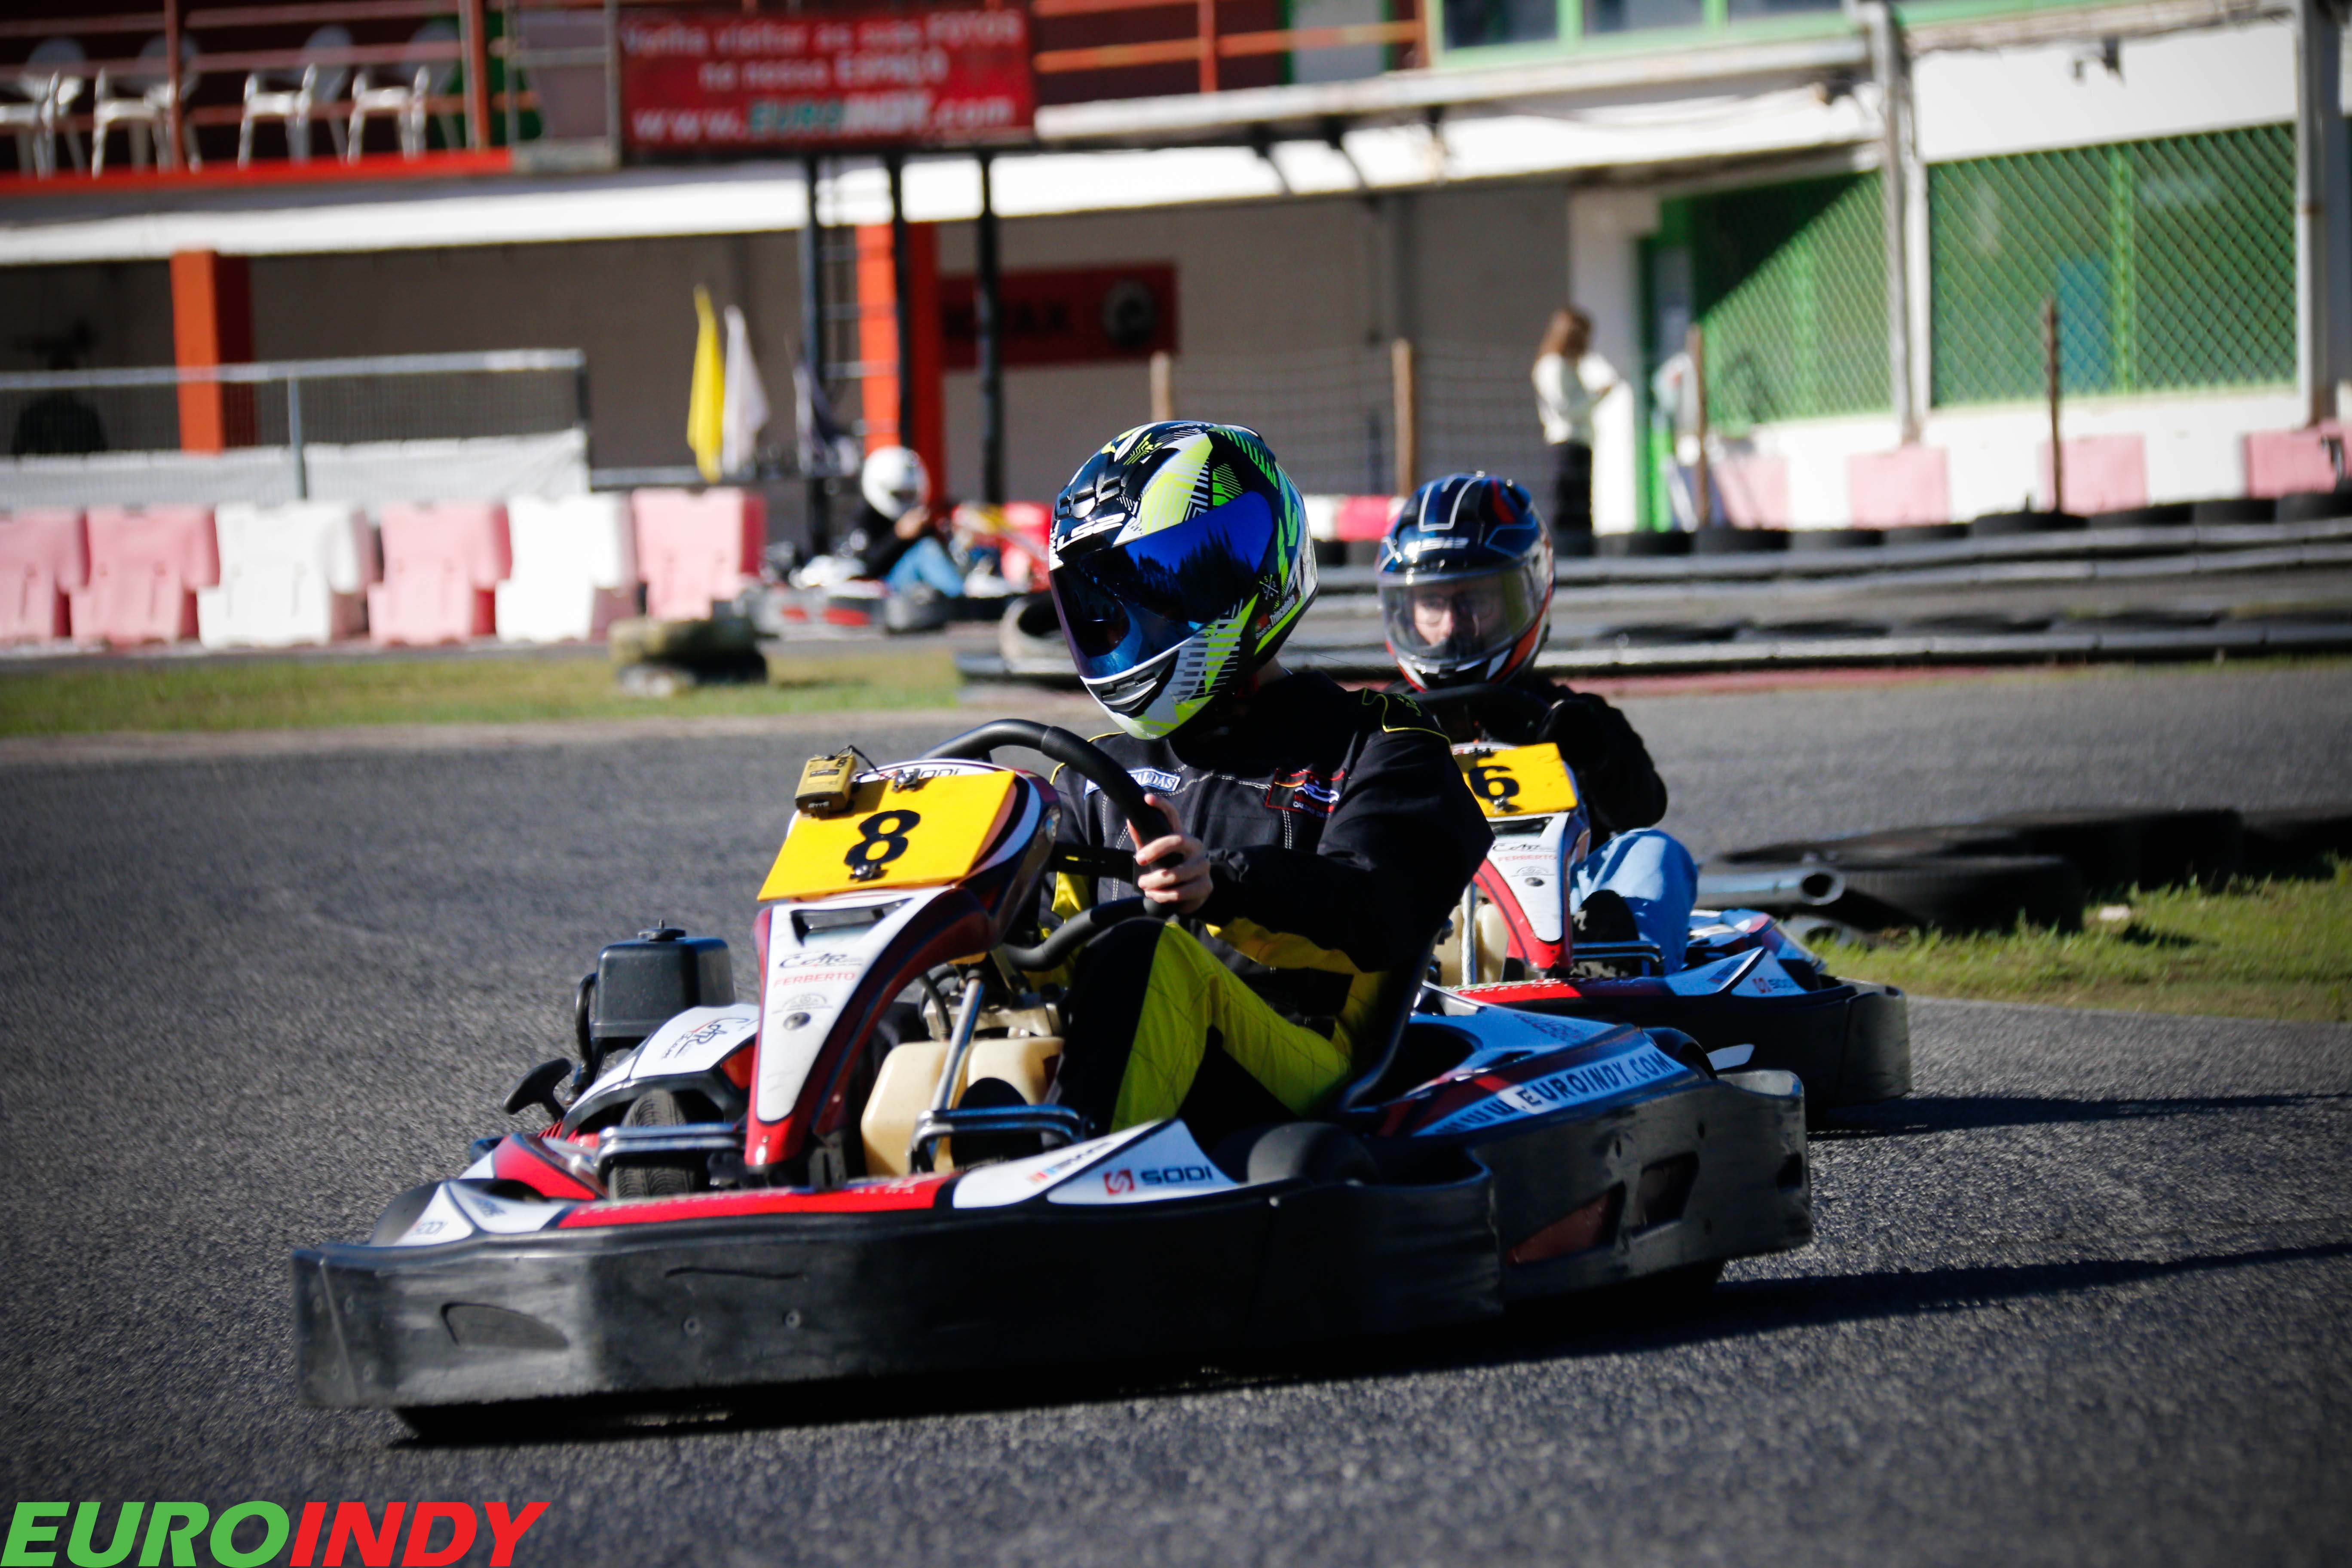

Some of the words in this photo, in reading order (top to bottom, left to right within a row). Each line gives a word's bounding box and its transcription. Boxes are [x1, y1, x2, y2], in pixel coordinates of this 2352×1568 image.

[1056, 512, 1126, 552] LS2
[1468, 766, 1520, 801] 6
[844, 809, 921, 866] 8
[773, 971, 856, 988] FERBERTO
[1140, 1166, 1213, 1185] SODI
